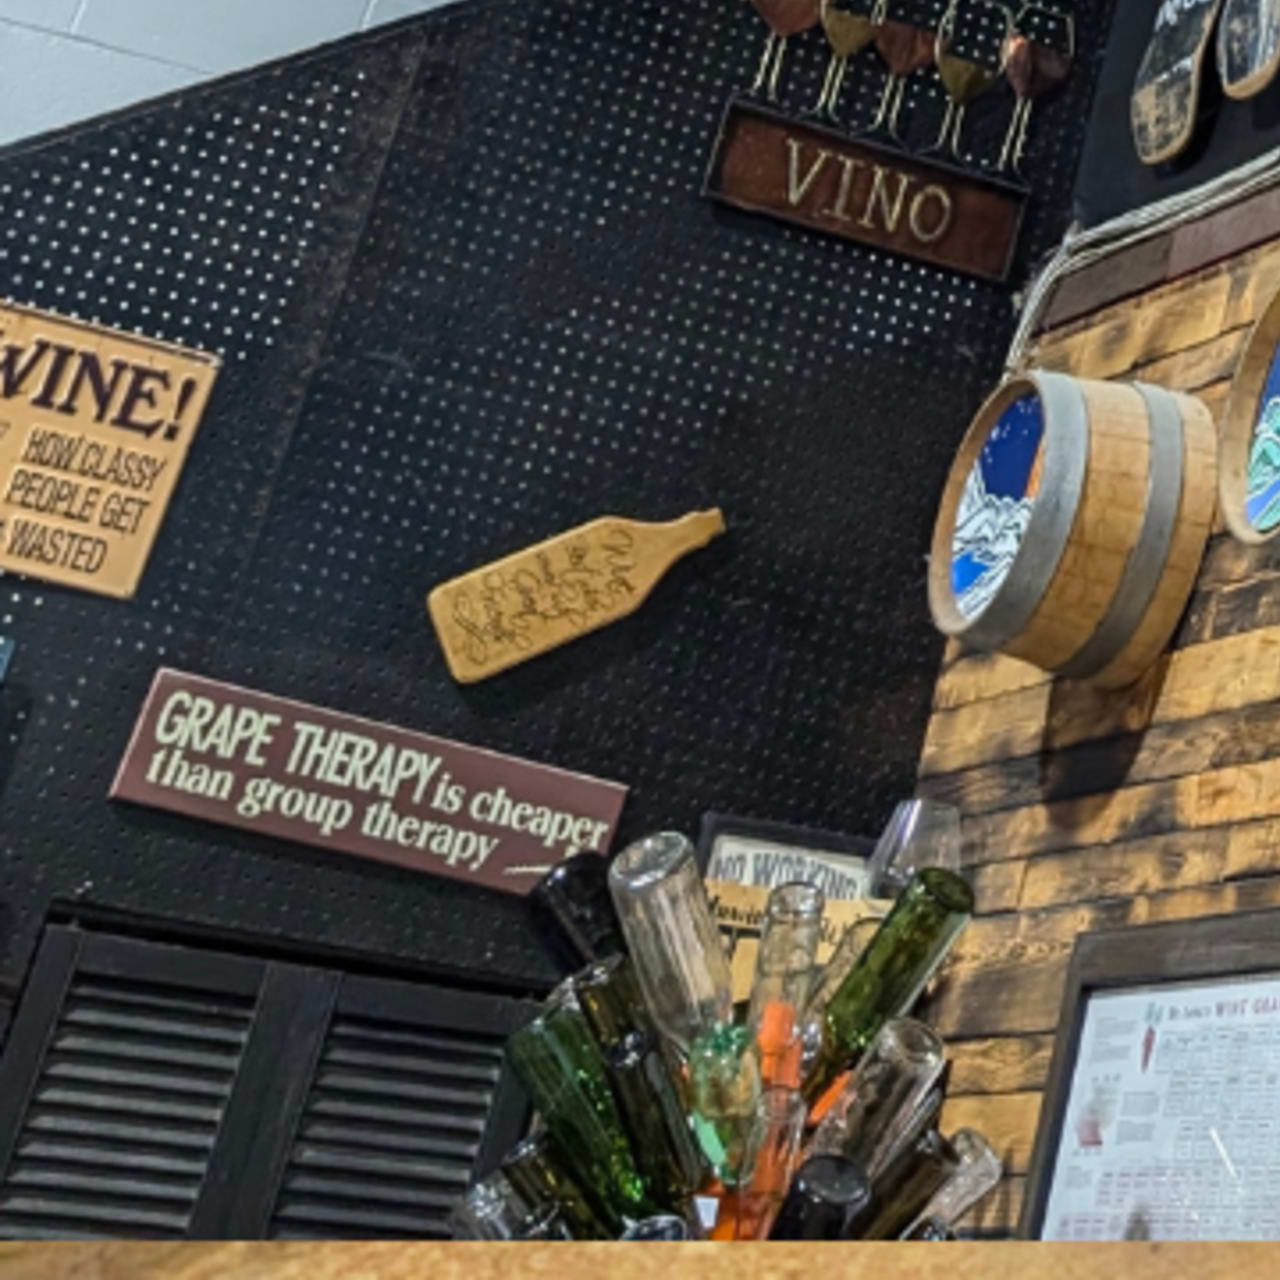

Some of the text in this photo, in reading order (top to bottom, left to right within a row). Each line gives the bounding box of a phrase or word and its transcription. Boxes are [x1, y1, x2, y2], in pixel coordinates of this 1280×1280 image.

[784, 137, 954, 244] VINO
[4, 468, 151, 536] PEOPLE GET
[23, 428, 169, 492] HOW CLASSY
[6, 517, 109, 574] WASTED
[145, 749, 499, 872] than group therapy
[154, 690, 609, 850] GRAPE THERAPY is cheaper
